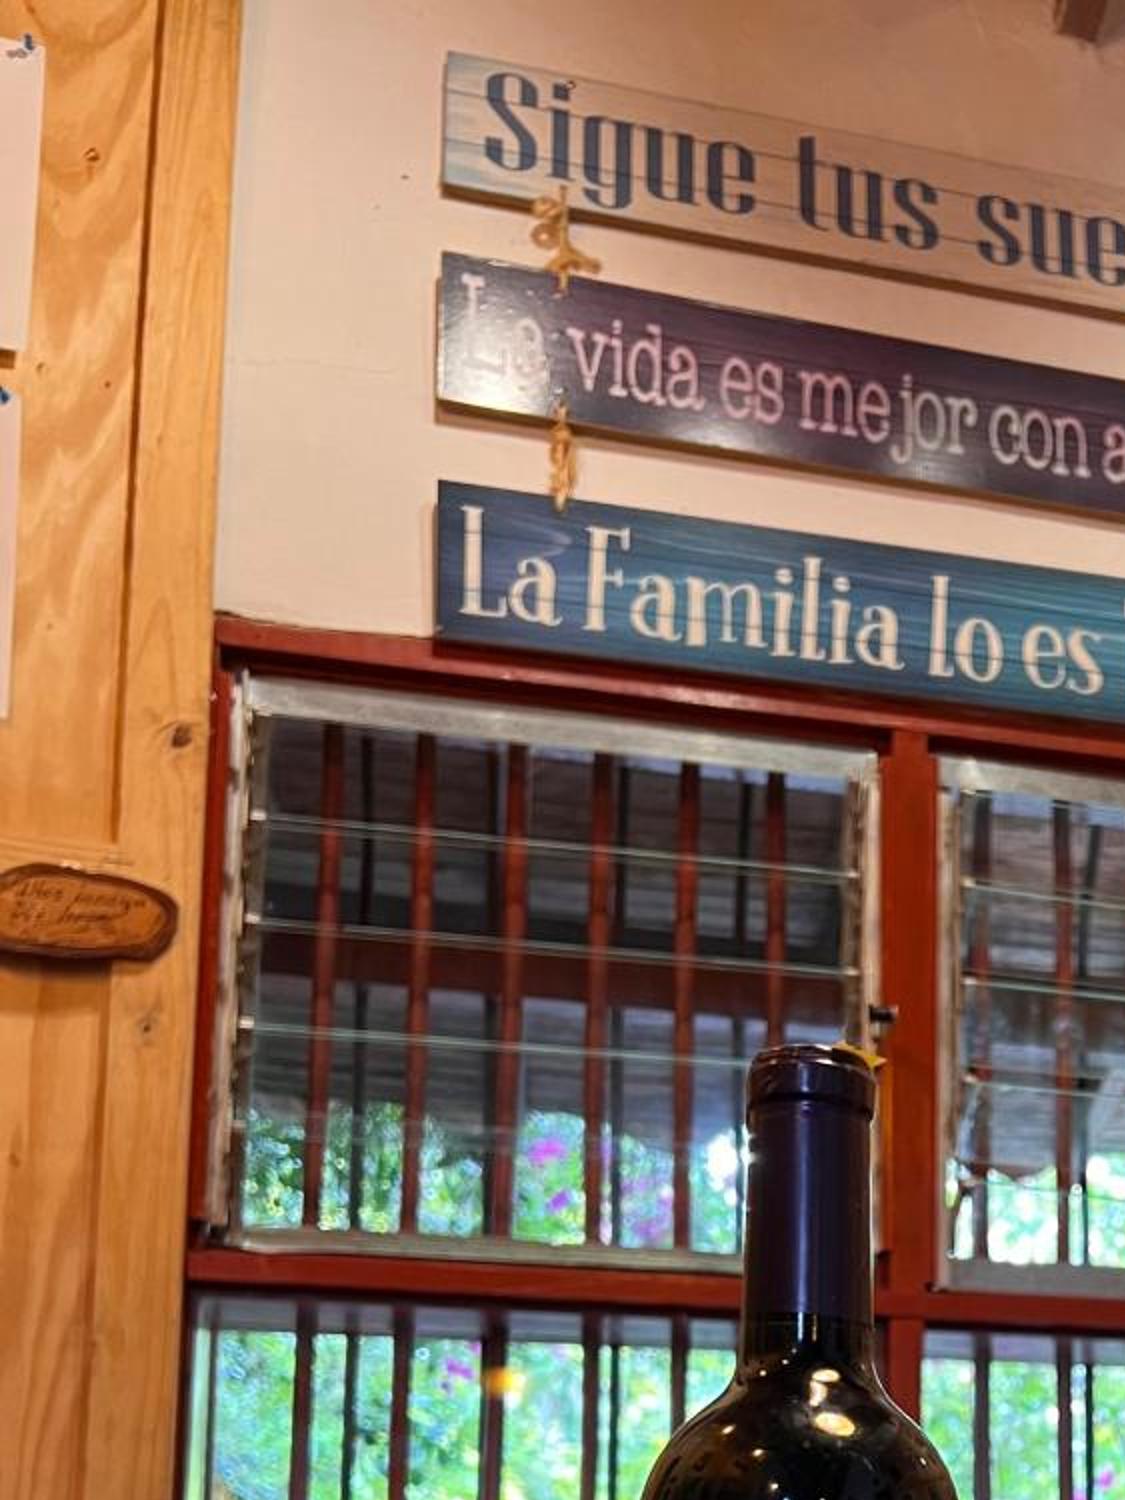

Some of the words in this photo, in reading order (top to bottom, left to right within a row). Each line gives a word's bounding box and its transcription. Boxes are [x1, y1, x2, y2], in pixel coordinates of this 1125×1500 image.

[482, 69, 758, 219] Sigue
[798, 133, 942, 252] tus
[565, 319, 705, 412] vida
[719, 353, 786, 429] es
[797, 365, 979, 466] mejor
[986, 404, 1093, 480] con
[457, 502, 564, 631] La
[581, 523, 906, 674] Familia
[926, 573, 1003, 687] lo
[1020, 619, 1106, 697] es
